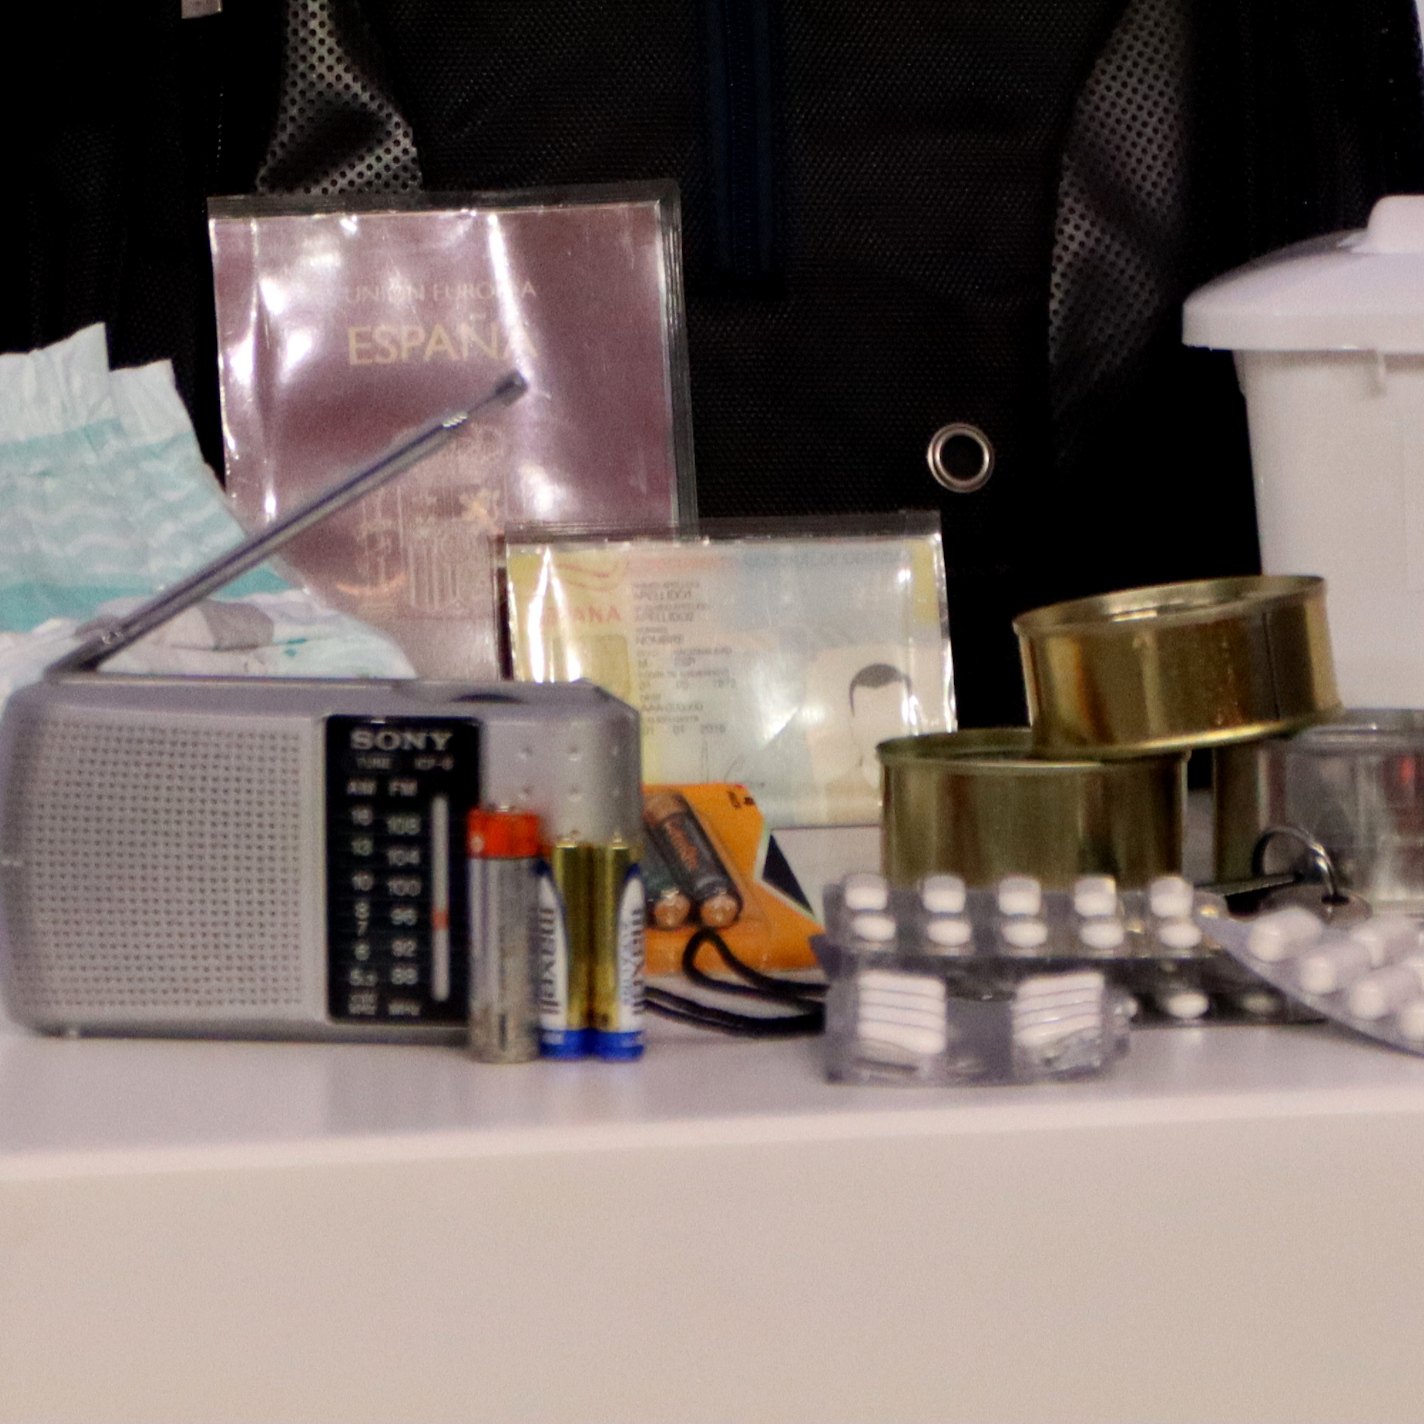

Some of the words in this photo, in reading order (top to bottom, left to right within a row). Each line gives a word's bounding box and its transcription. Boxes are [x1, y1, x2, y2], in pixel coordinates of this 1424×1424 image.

[347, 282, 425, 303] UNIN
[433, 280, 537, 301] EUROA
[347, 312, 539, 365] ESPAÑA
[350, 727, 454, 750] SONY
[351, 871, 375, 891] 10
[387, 878, 422, 896] 100
[357, 920, 368, 936] 7
[391, 938, 418, 957] 92
